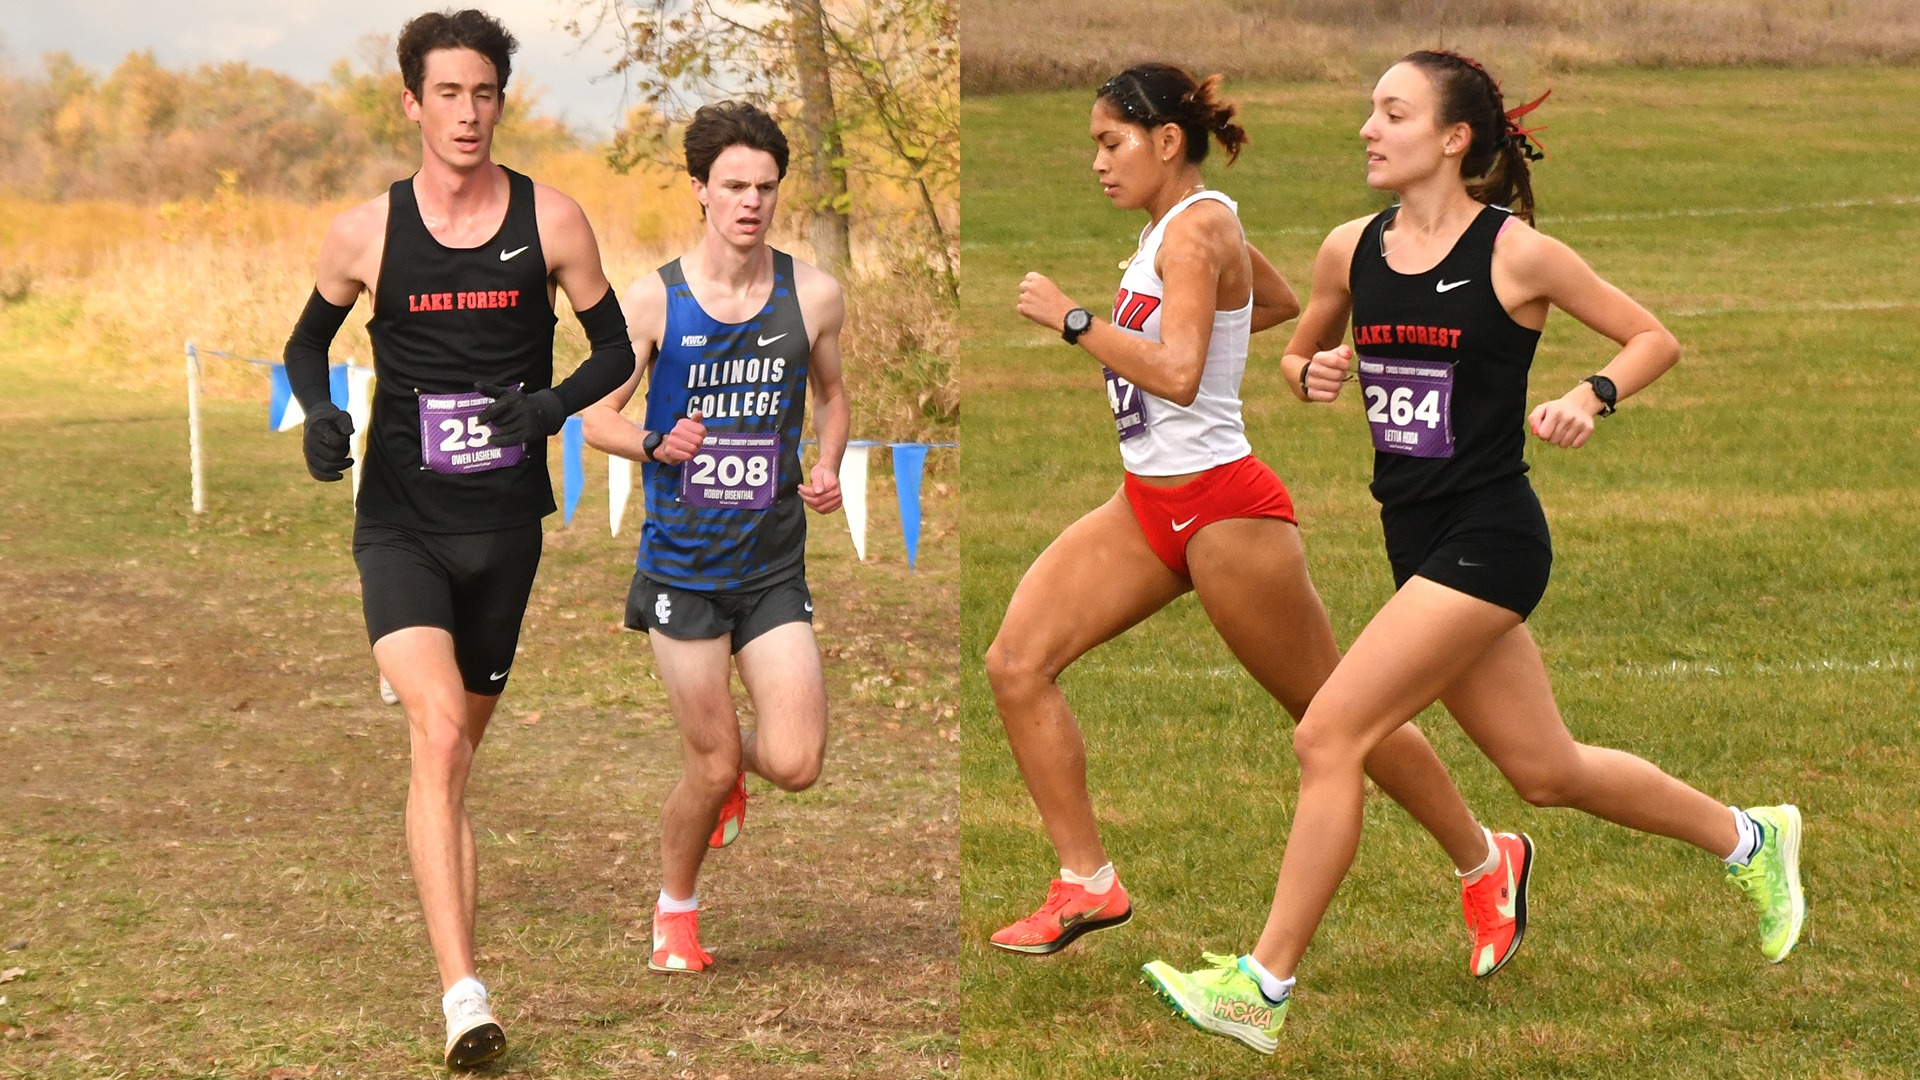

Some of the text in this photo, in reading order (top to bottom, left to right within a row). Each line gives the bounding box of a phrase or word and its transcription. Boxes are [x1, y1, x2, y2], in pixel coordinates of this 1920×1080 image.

[408, 290, 519, 312] LAKE FOREST
[1354, 324, 1462, 348] LAKE FOREST
[687, 357, 786, 389] ILLINOIS
[686, 391, 781, 418] COLLEGE
[1365, 385, 1440, 429] 264
[451, 453, 471, 465] OWEN
[690, 454, 768, 487] 208
[703, 488, 754, 500] ROBBY BISENTHAL
[1213, 996, 1273, 1030] HOKA
